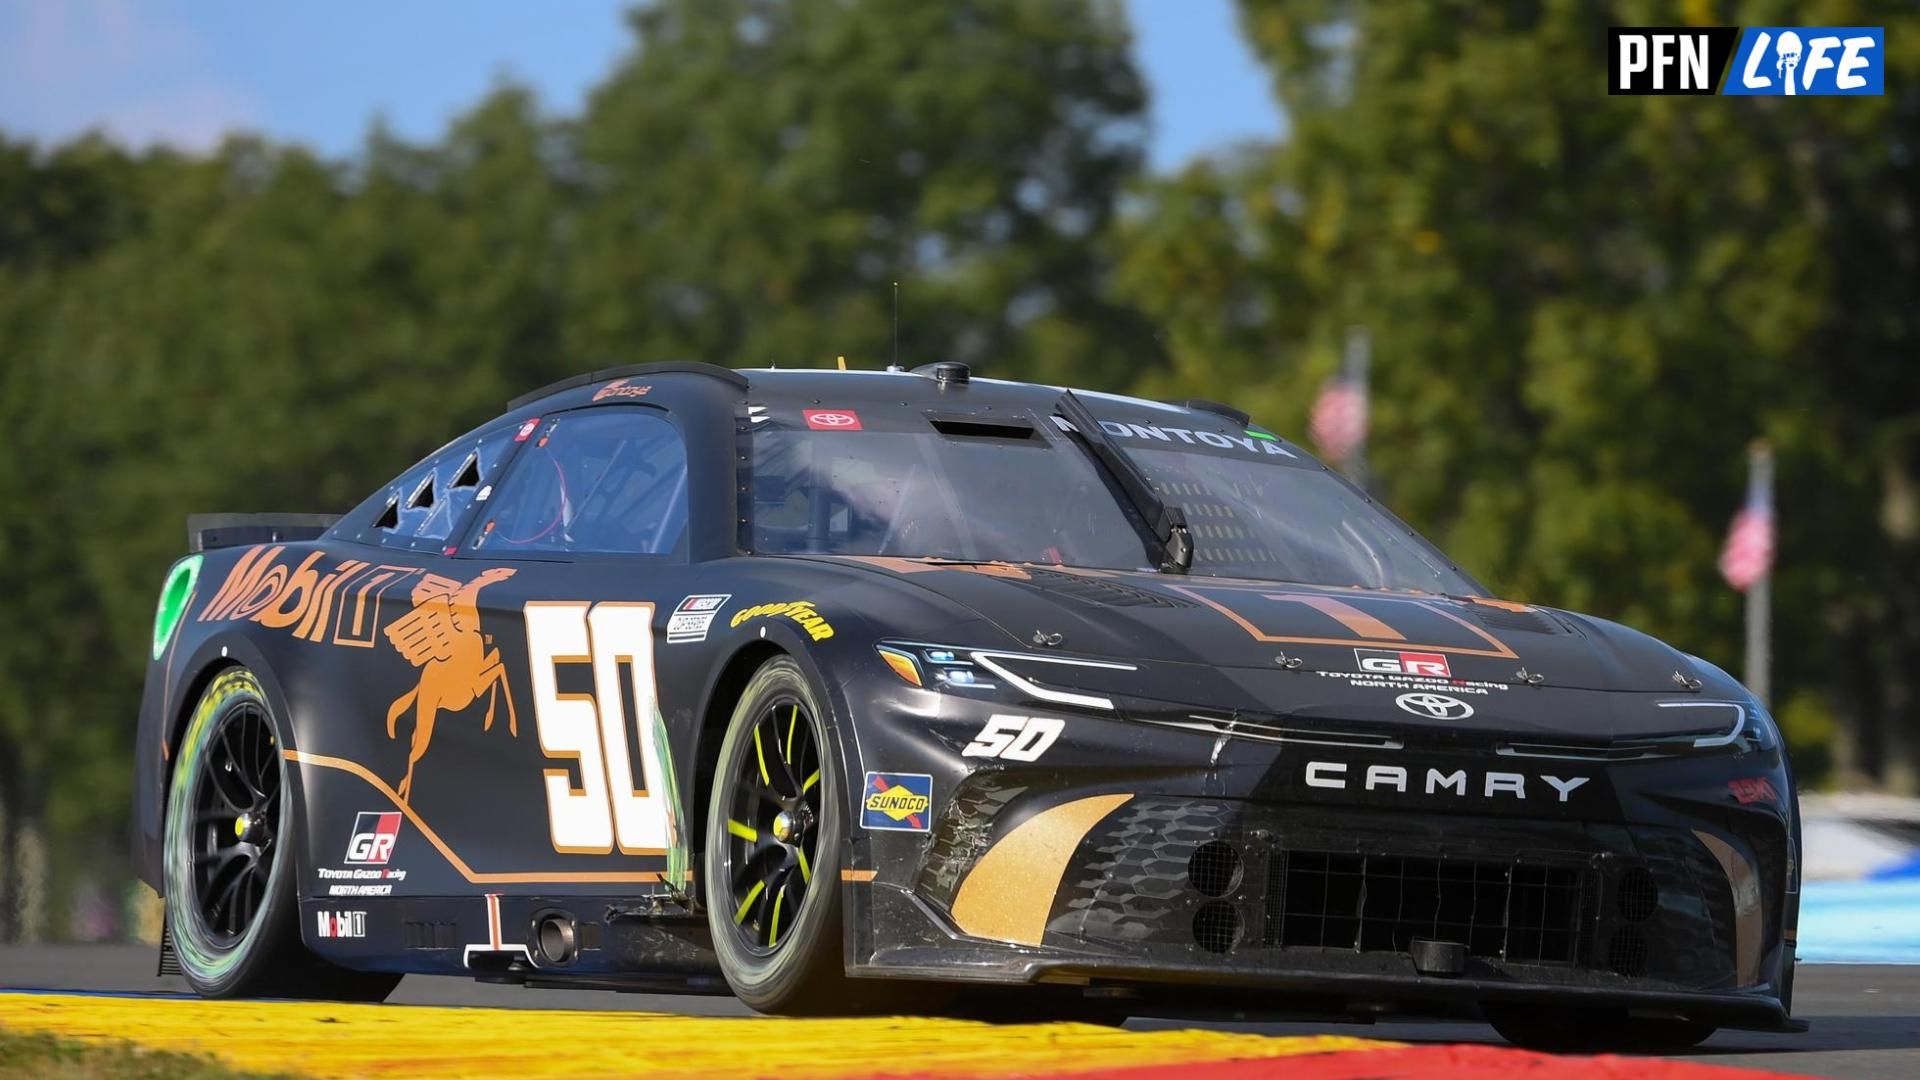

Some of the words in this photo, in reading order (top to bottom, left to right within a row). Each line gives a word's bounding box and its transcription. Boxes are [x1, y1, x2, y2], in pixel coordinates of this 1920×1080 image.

[197, 544, 371, 643] Mobil
[1315, 670, 1385, 680] TOYOTA
[1361, 657, 1450, 677] GR
[1350, 679, 1410, 690] NORTH
[1417, 683, 1489, 695] AMERICA
[523, 600, 678, 856] 50
[961, 713, 1066, 763] 50
[1304, 761, 1591, 802] CAMRY
[869, 795, 927, 811] SUNOCO
[349, 832, 396, 861] GR
[316, 910, 354, 937] Mobil
